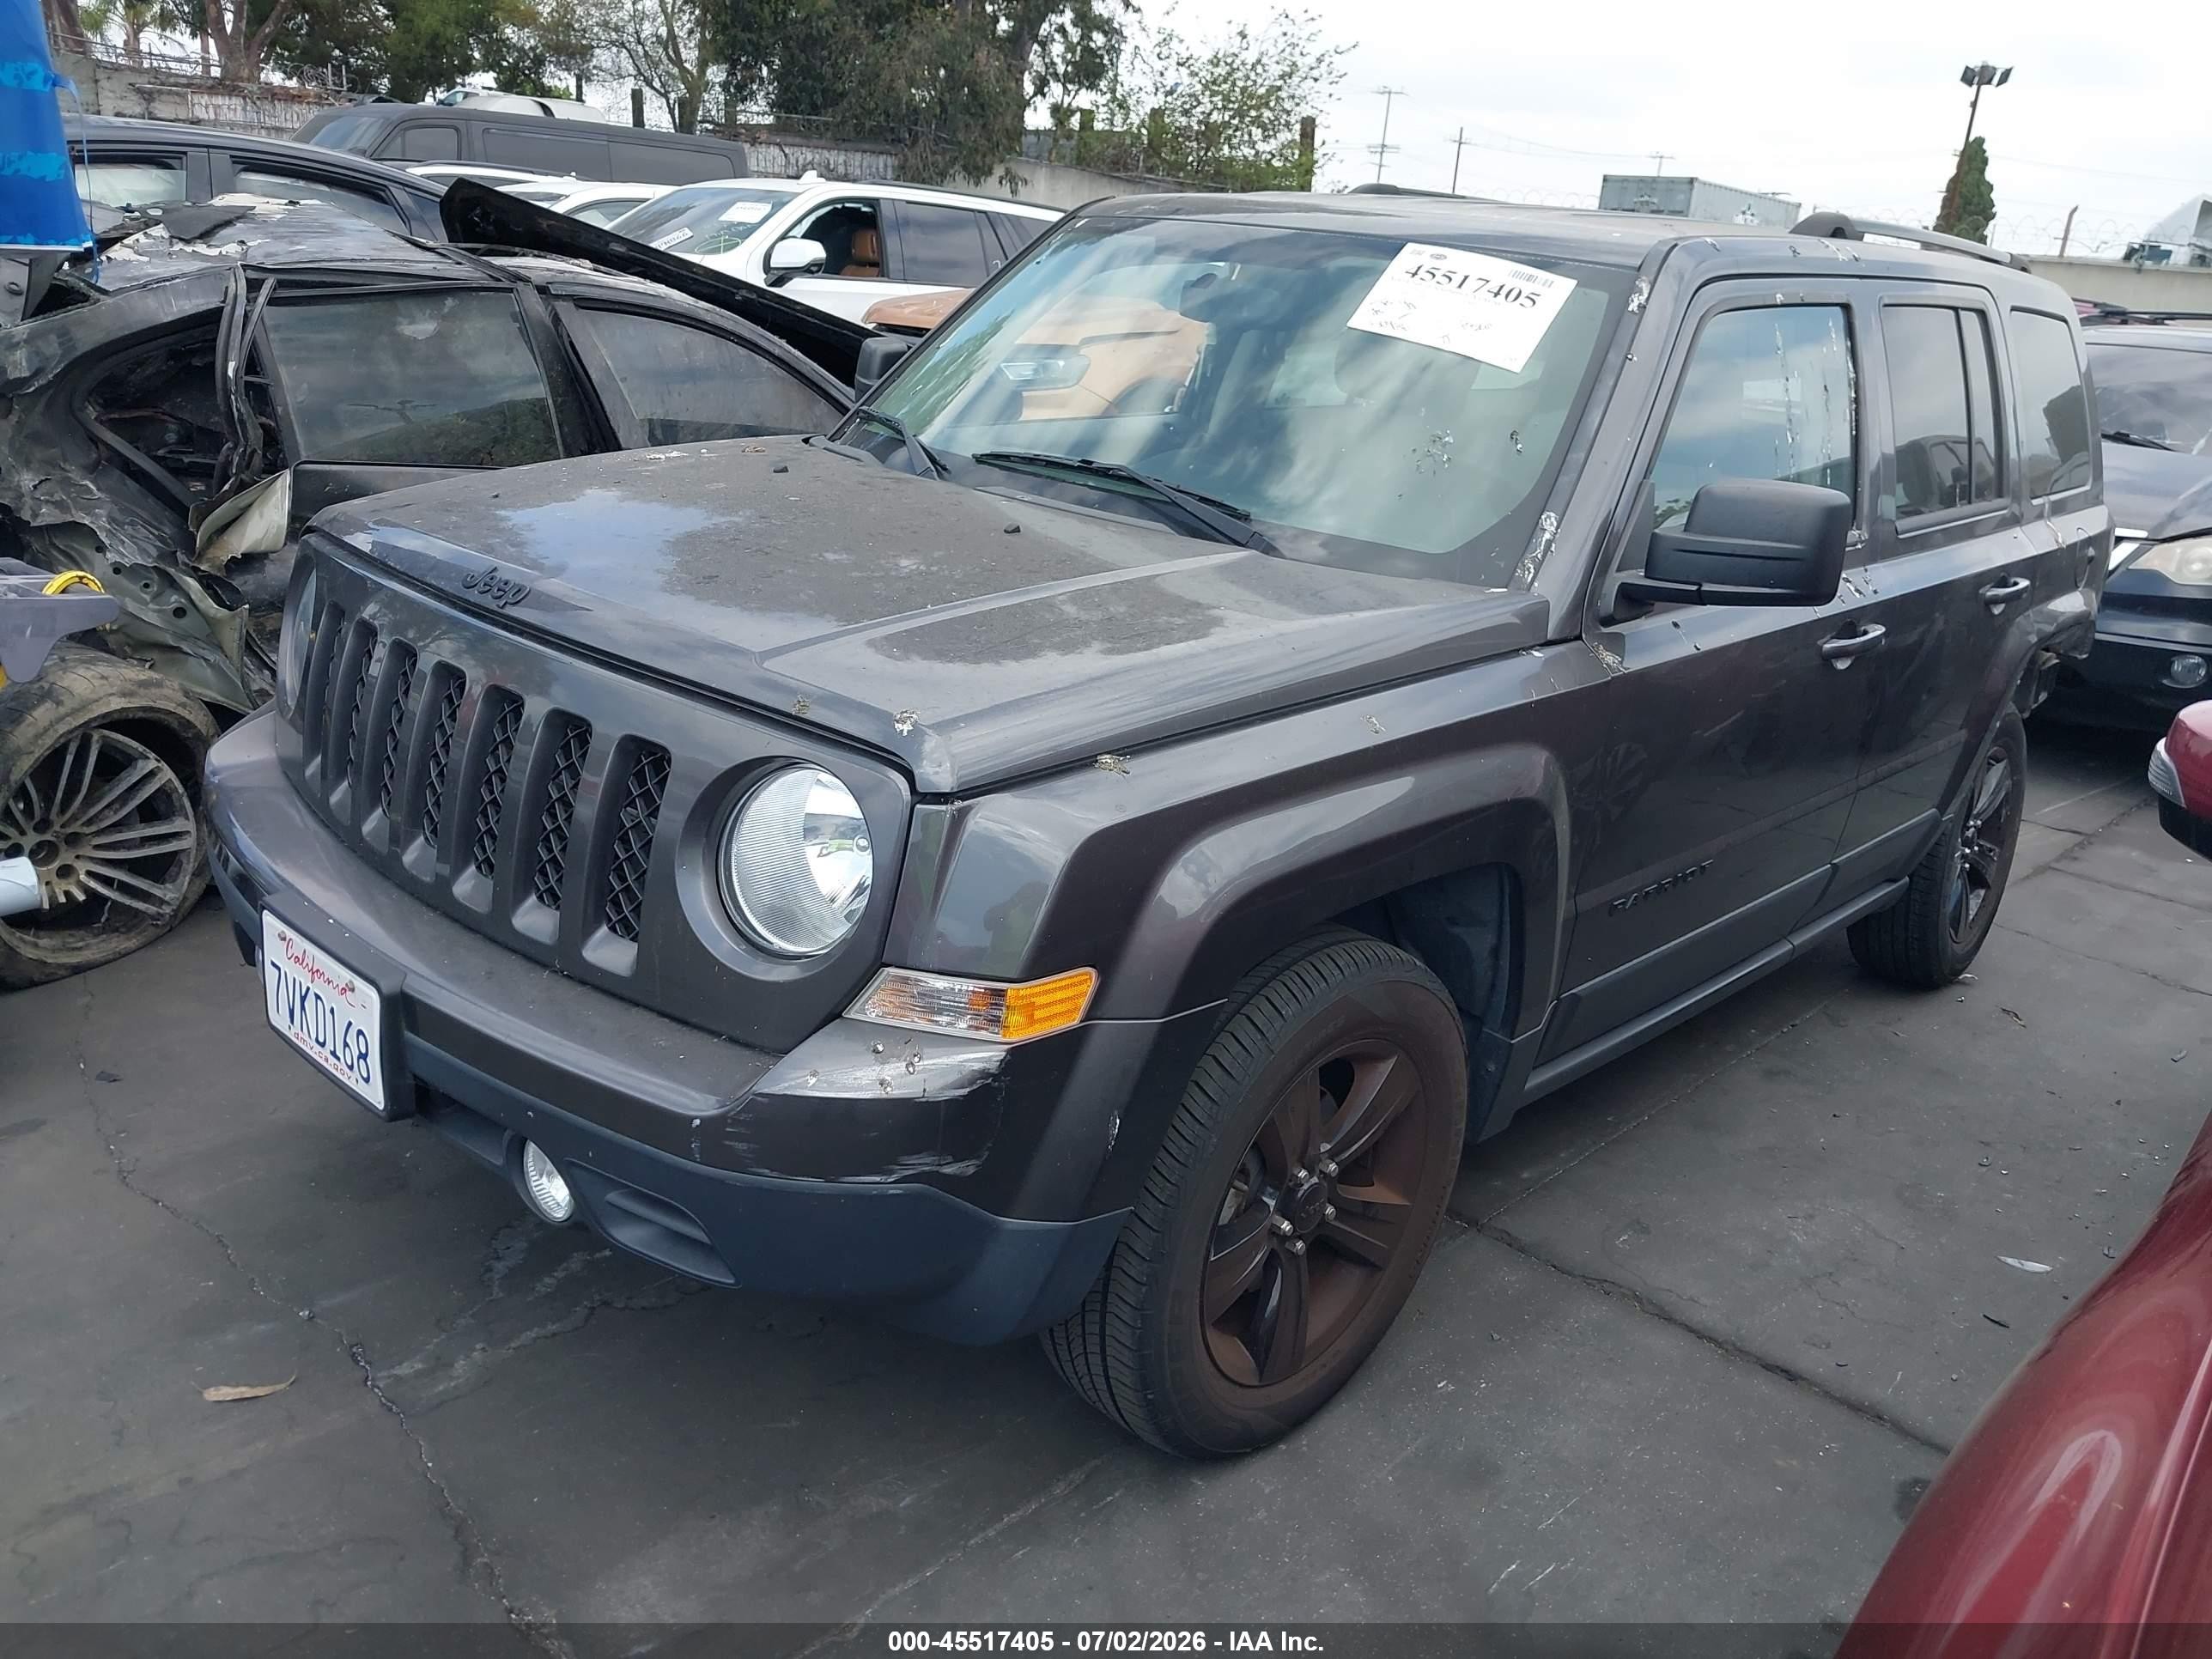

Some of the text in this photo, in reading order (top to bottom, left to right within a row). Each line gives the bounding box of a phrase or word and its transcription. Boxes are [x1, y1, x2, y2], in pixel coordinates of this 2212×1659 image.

[1405, 264, 1542, 309] 45517405
[461, 566, 531, 609] Jeep
[284, 938, 355, 1008] California
[270, 960, 370, 1084] 7VKD168
[294, 1031, 352, 1080] dmv.ca.gov
